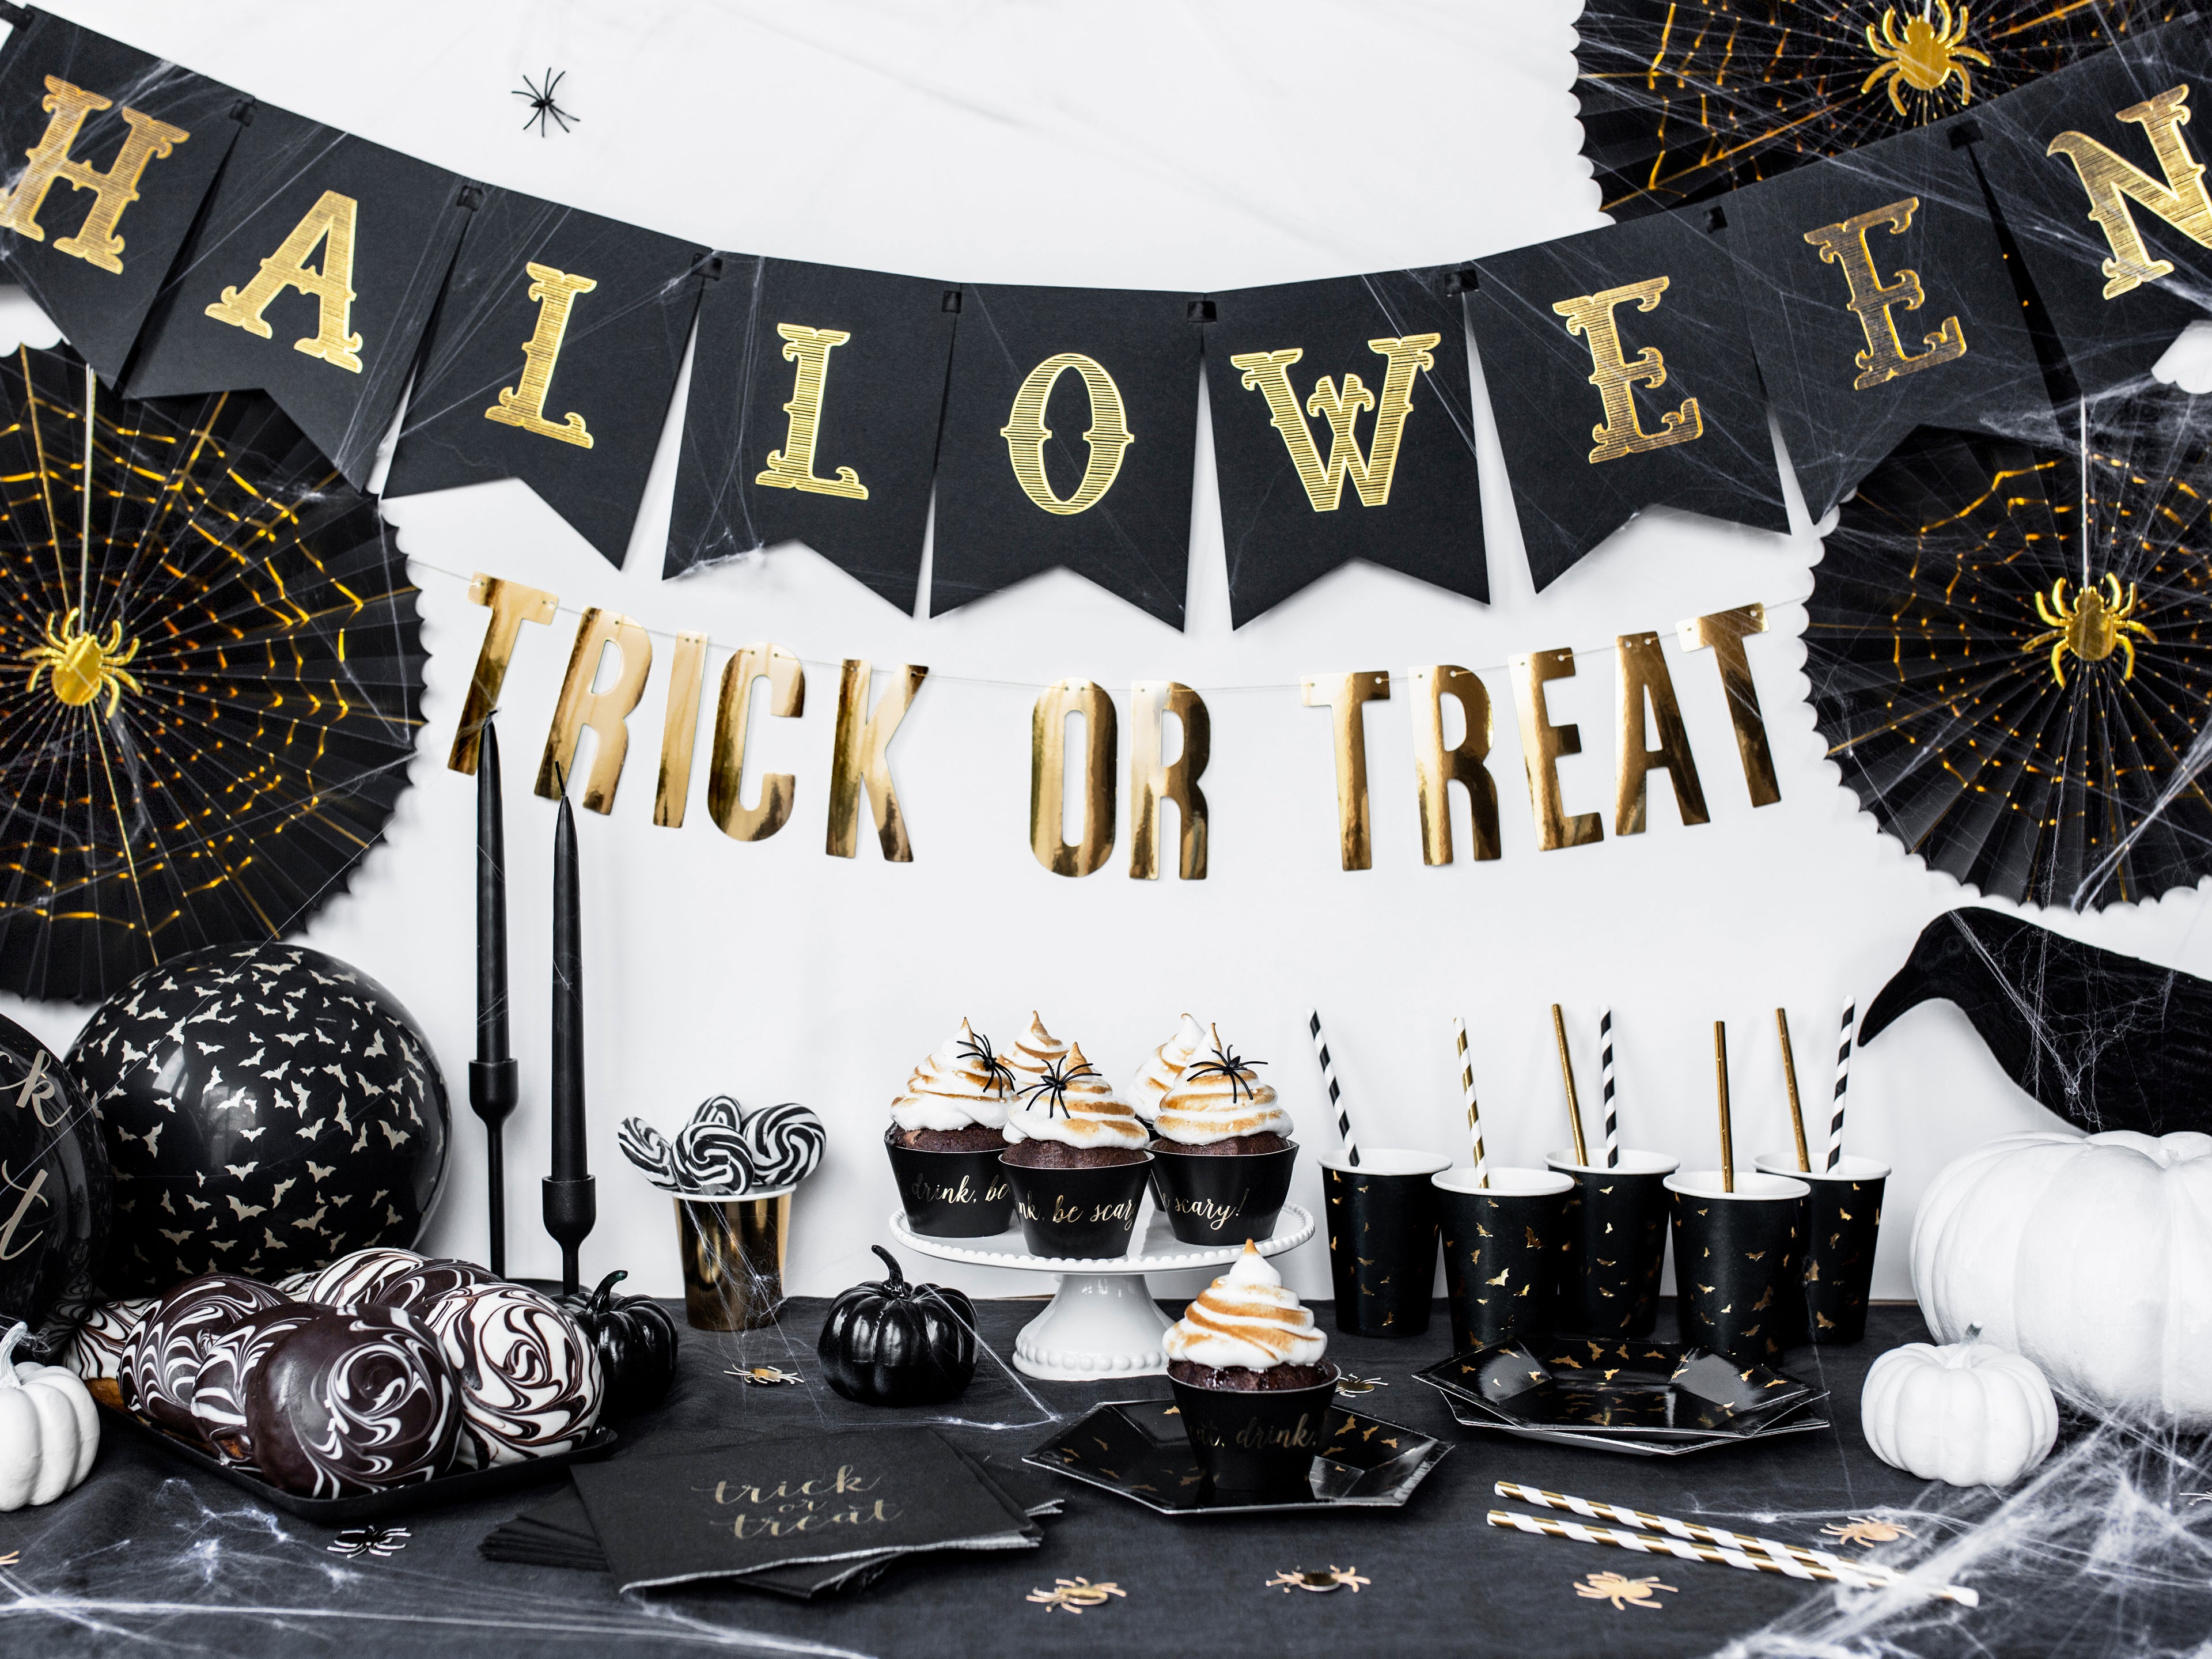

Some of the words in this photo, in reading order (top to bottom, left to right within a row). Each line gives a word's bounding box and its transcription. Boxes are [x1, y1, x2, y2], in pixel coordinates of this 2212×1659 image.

[0, 74, 2212, 515] HALLOWEEN
[448, 571, 929, 862] TRICK
[1030, 677, 1211, 880] OR
[1300, 603, 1781, 872] TREAT
[1052, 1195, 1084, 1223] be
[1175, 1188, 1249, 1230] scary!
[691, 1464, 883, 1505] trick
[778, 1498, 828, 1513] or
[709, 1498, 904, 1540] treat
